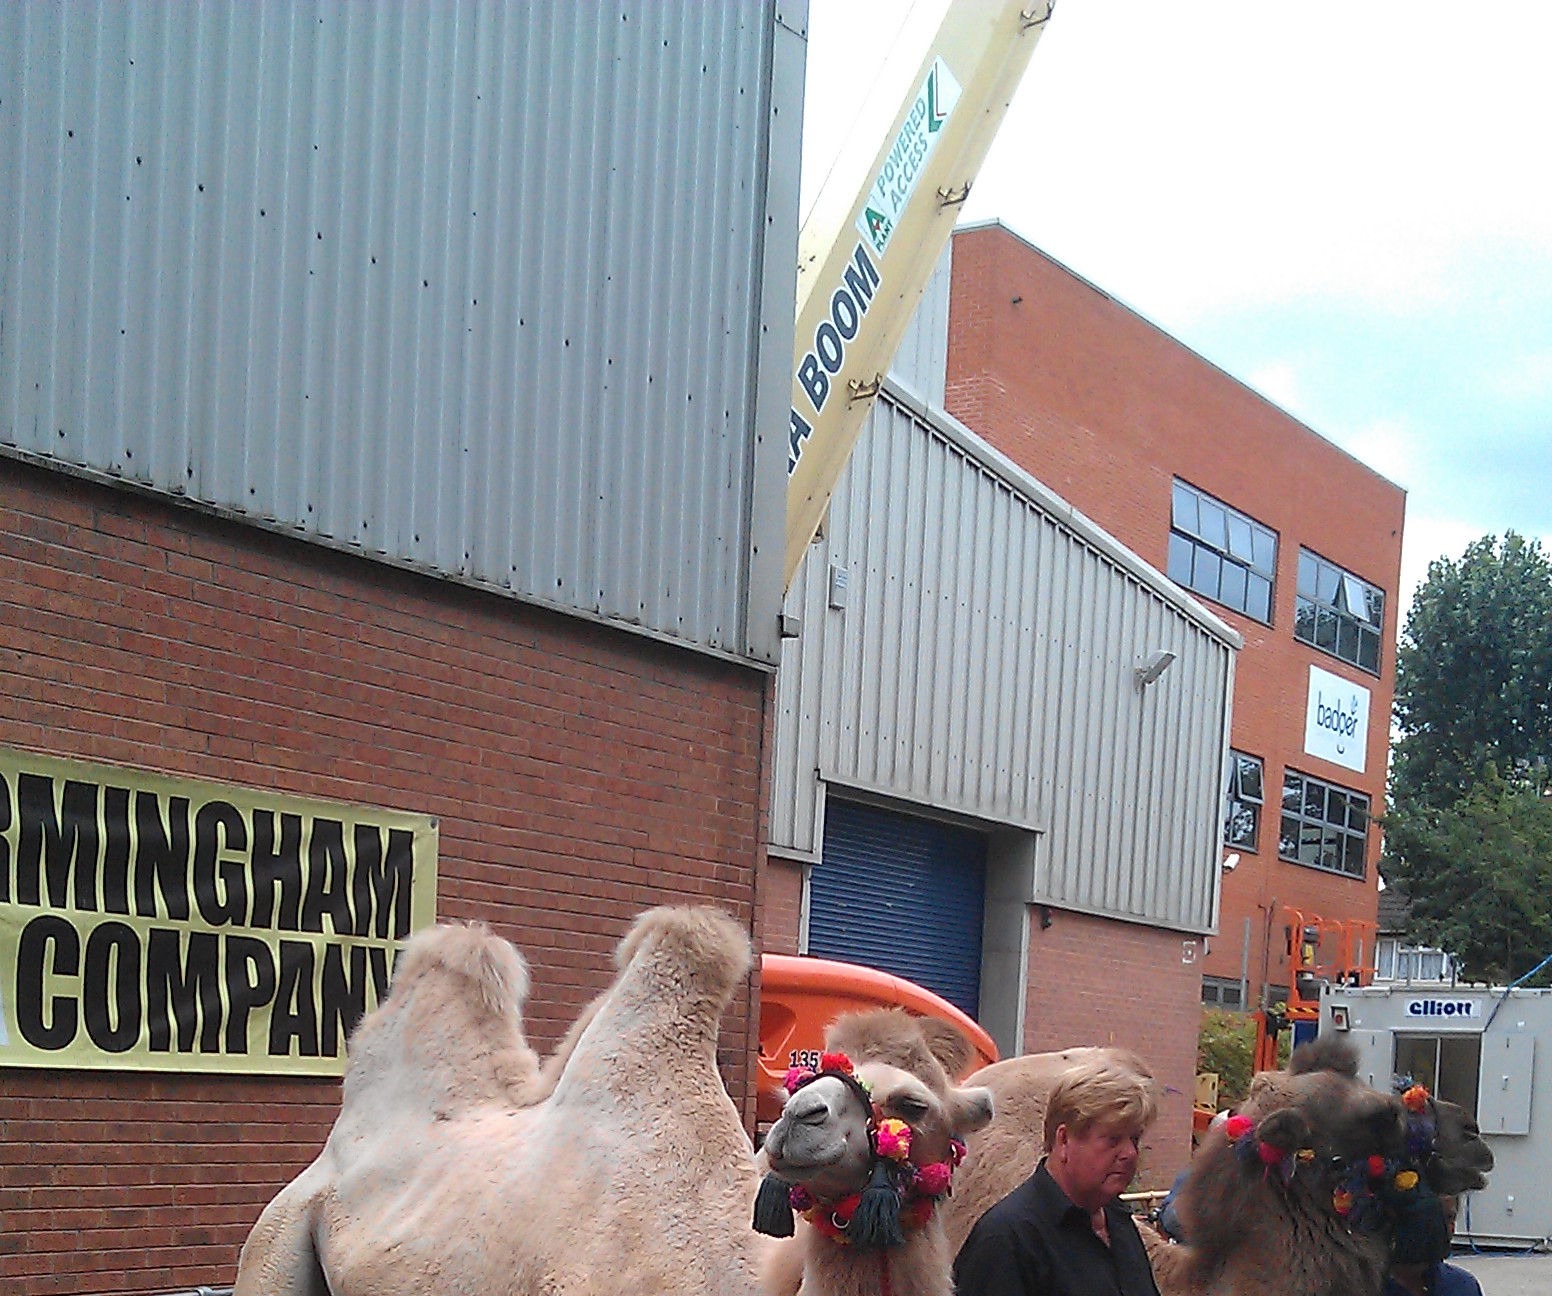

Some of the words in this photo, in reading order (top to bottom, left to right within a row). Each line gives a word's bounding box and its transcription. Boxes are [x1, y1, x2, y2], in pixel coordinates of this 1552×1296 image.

[877, 98, 926, 198] POWERED
[890, 132, 928, 213] ACCESS
[797, 241, 881, 414] BOOM
[0, 771, 414, 941] MINGHAM
